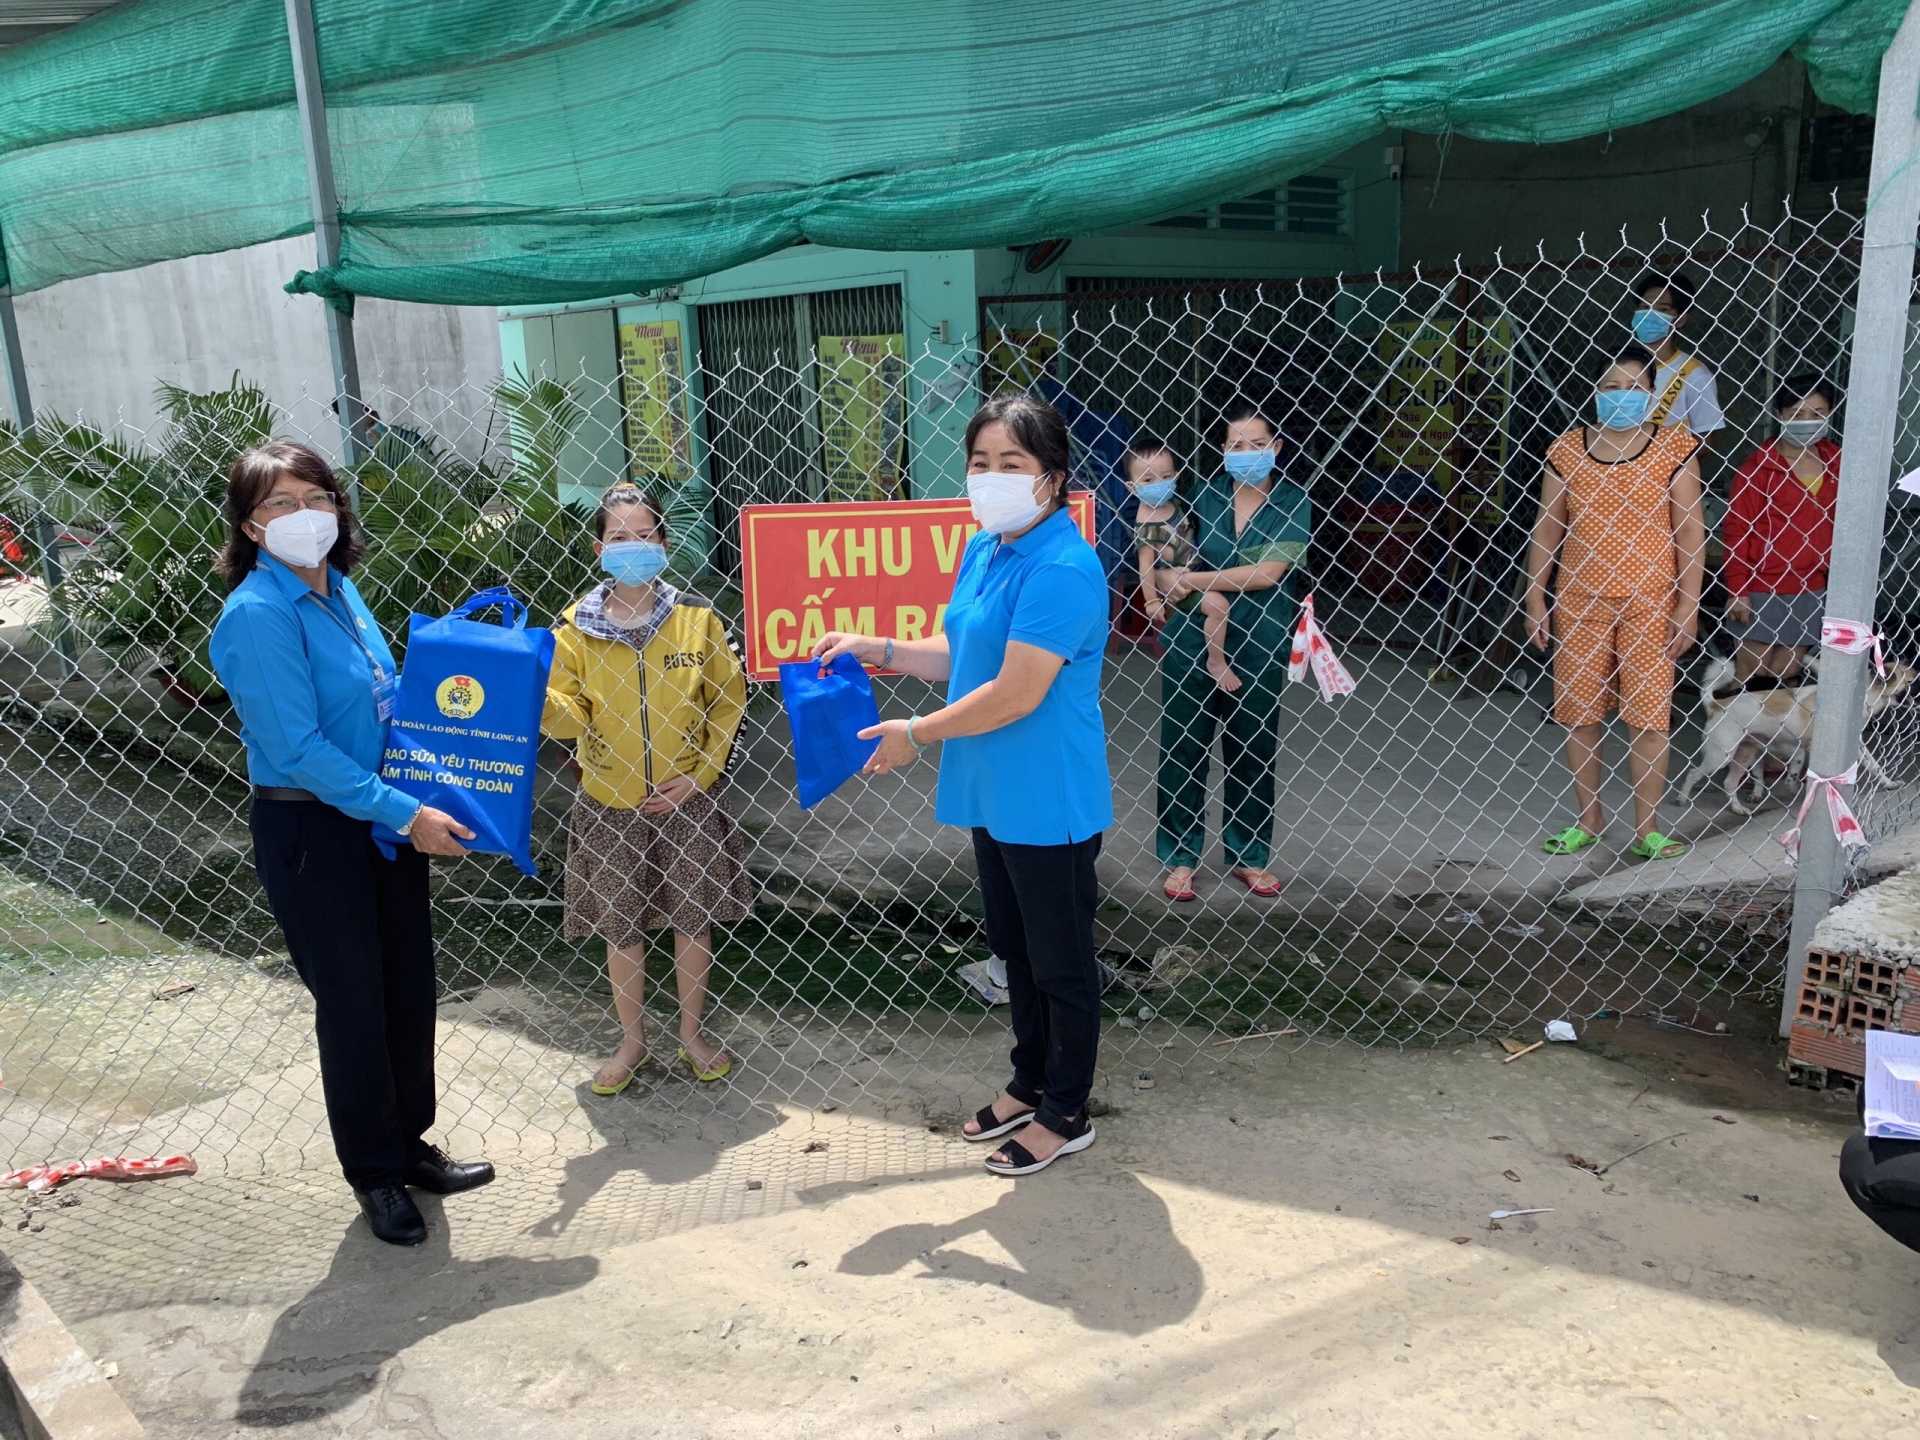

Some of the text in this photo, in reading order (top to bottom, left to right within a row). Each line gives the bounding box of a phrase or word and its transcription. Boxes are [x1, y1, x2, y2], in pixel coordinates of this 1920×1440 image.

[635, 325, 663, 339] Menu
[807, 526, 912, 578] KHU
[765, 587, 876, 659] CẤM
[663, 651, 705, 670] GUESS
[401, 720, 426, 730] ĐOÀN
[427, 723, 444, 733] LAO
[445, 726, 469, 736] ĐỘNG
[491, 732, 515, 742] LONG
[384, 748, 525, 776] RAO SỮA YÊU THƯƠNG
[381, 763, 513, 794] ẤM TÌNH CÔNG ĐOÀN
